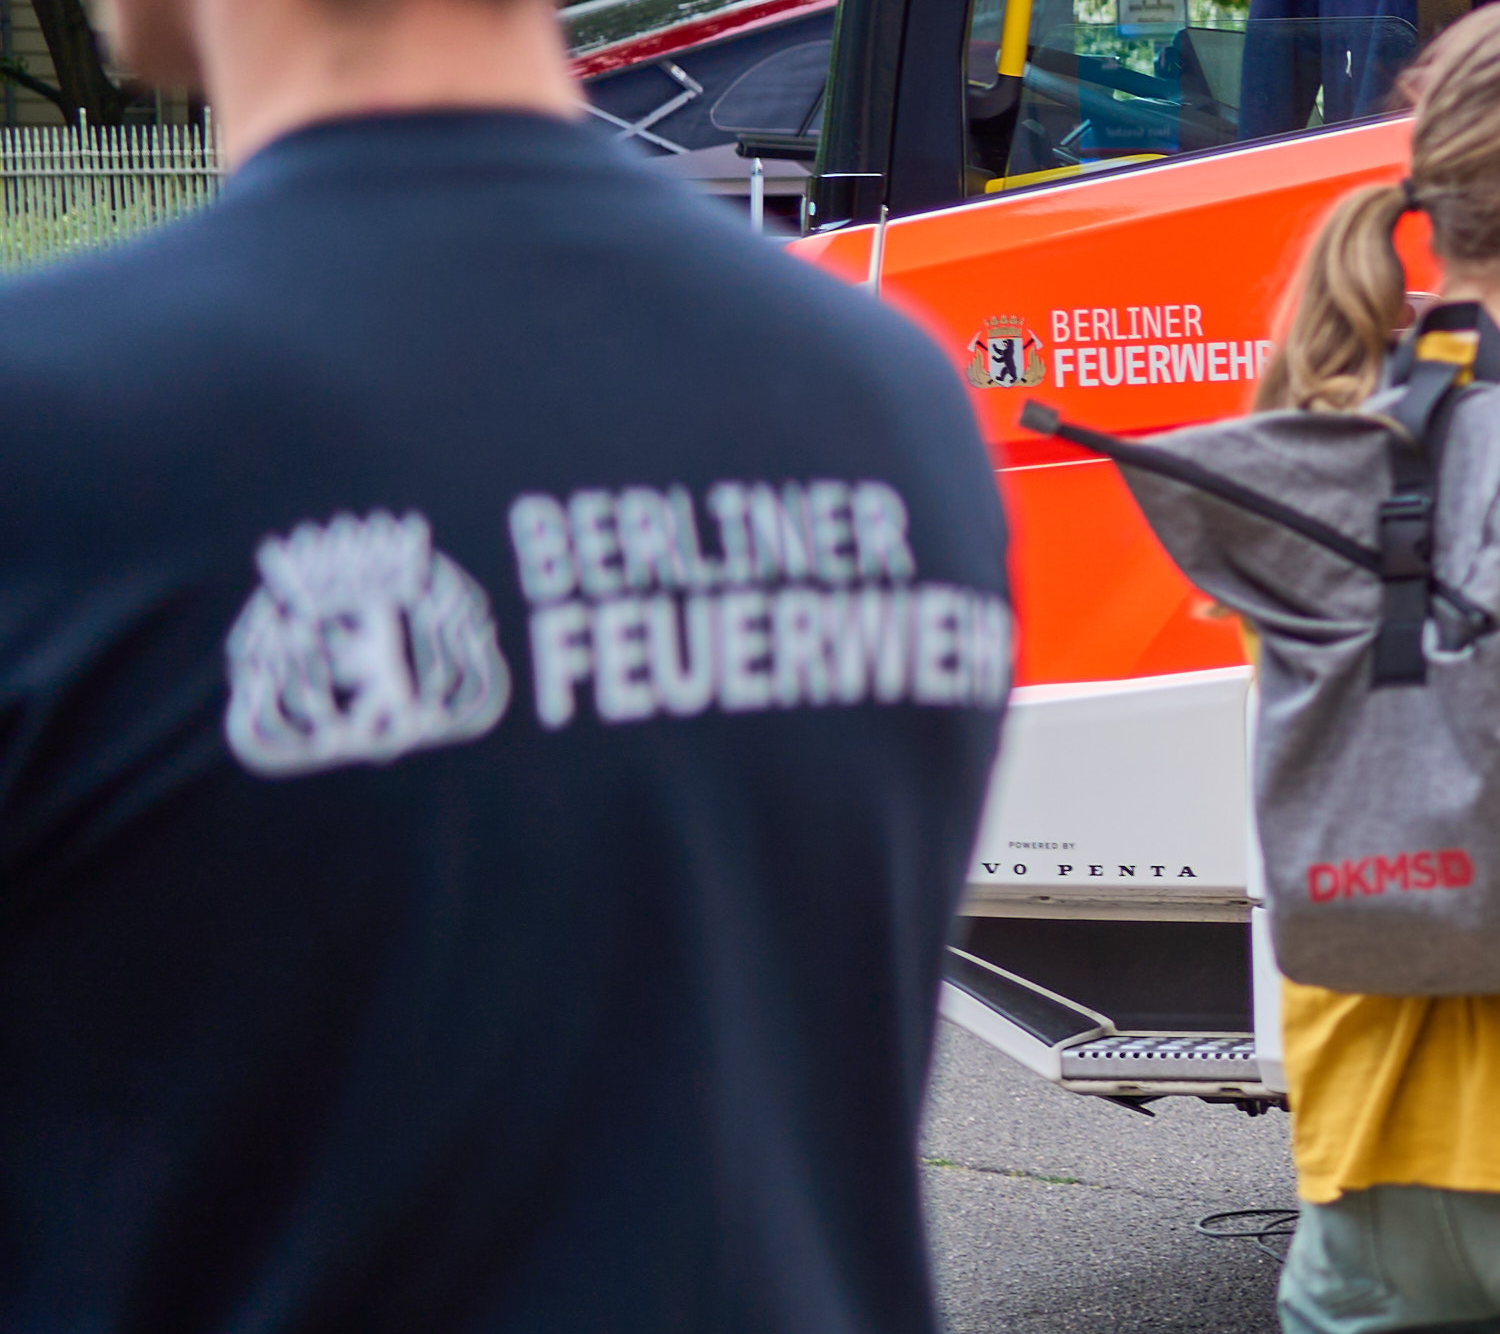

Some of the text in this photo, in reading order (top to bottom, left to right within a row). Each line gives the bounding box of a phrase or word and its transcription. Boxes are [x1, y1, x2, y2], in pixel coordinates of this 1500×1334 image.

[1052, 304, 1204, 343] BERLINER
[508, 479, 914, 604] BERLINER
[531, 581, 1016, 732] FEUERWEH
[1008, 841, 1077, 850] POWERED BY
[1057, 864, 1198, 878] PENTA
